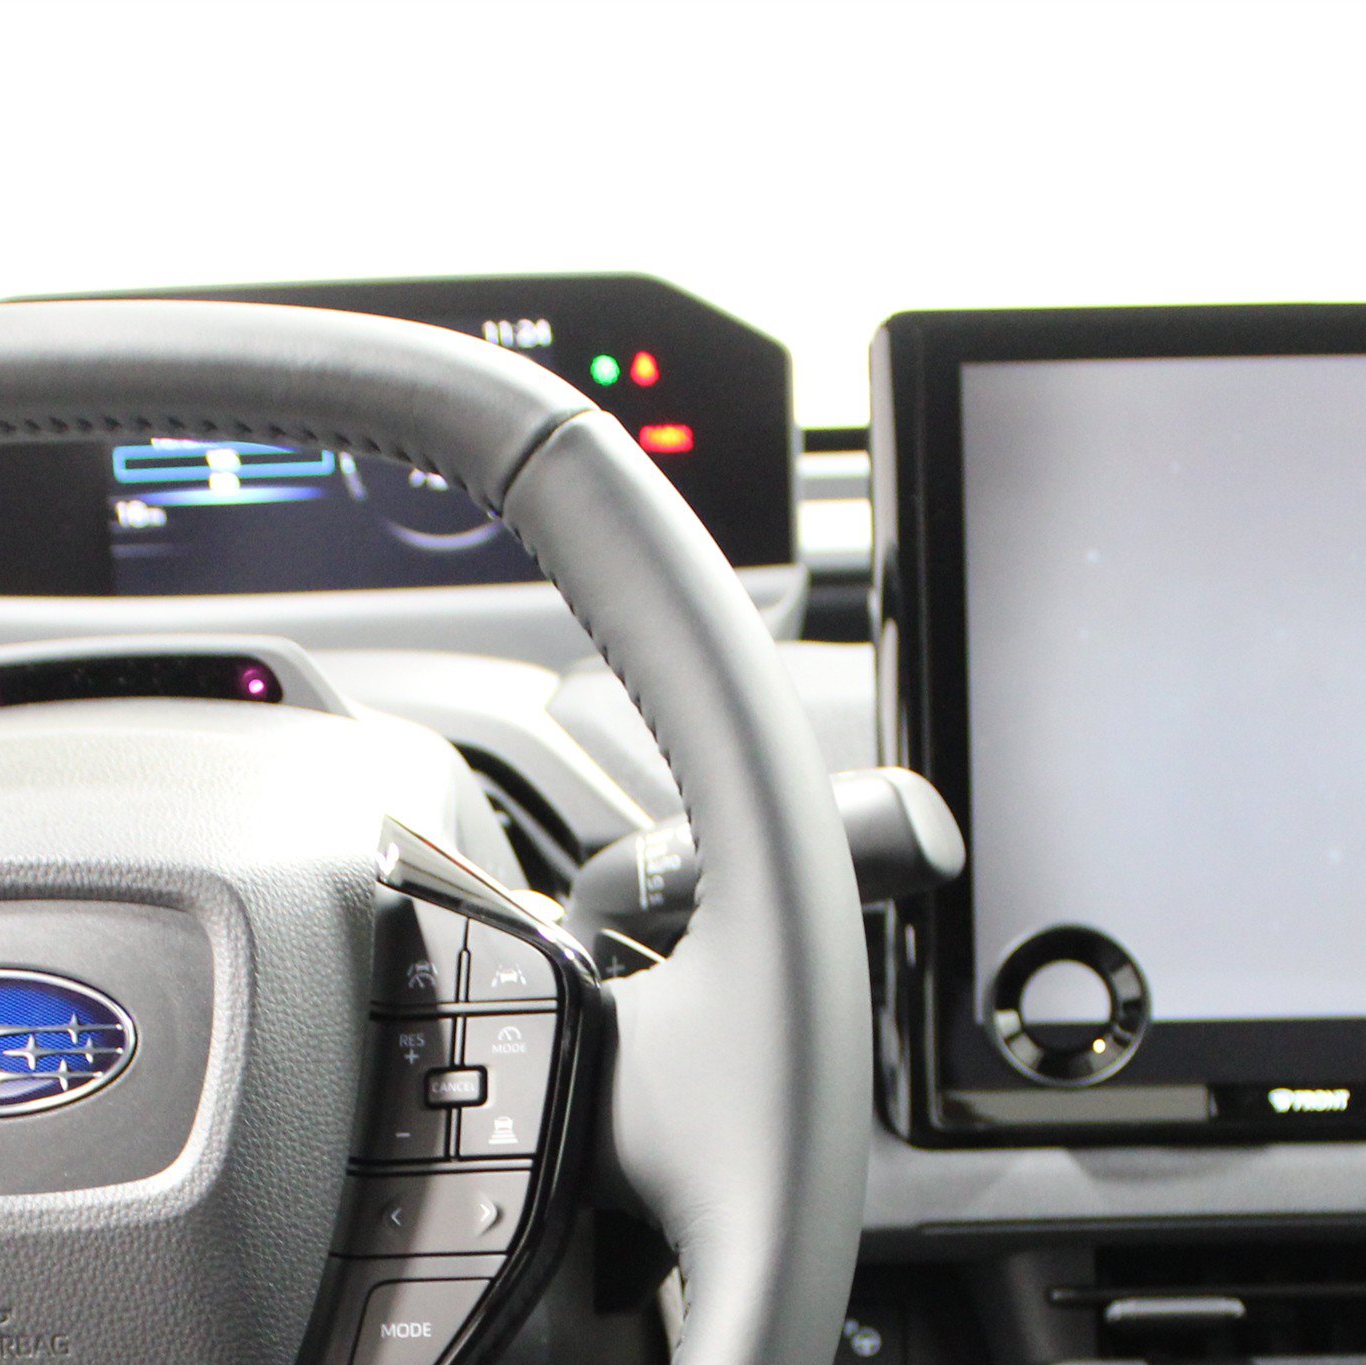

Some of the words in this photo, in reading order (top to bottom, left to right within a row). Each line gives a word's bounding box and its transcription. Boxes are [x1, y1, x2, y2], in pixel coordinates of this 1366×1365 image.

[398, 1032, 426, 1048] RES
[490, 1042, 527, 1055] MODE
[430, 1080, 477, 1094] CANCEL
[380, 1321, 432, 1339] MODE
